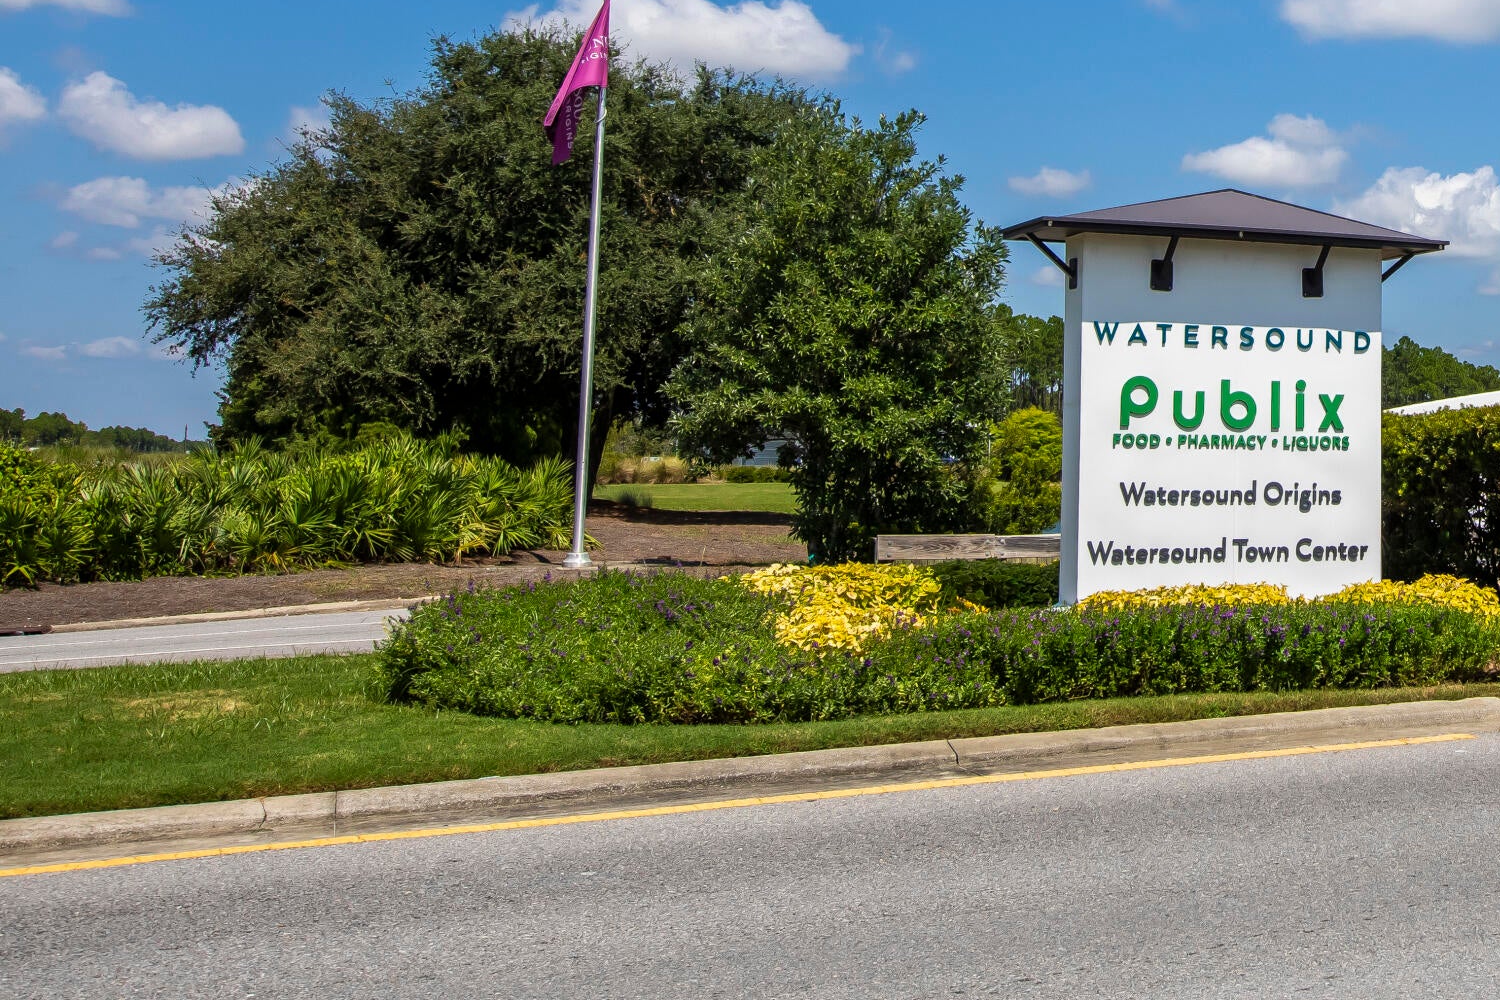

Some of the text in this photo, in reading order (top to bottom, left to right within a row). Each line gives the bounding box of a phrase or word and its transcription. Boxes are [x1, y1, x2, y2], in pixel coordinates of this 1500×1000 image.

[1094, 320, 1371, 353] WATERSOUND
[1120, 375, 1345, 431] Publix
[1112, 433, 1350, 452] FOOD PHARMACY LIQUORS
[1119, 480, 1342, 513] Watersound Origins
[1087, 537, 1369, 566] Watersound Town Center
